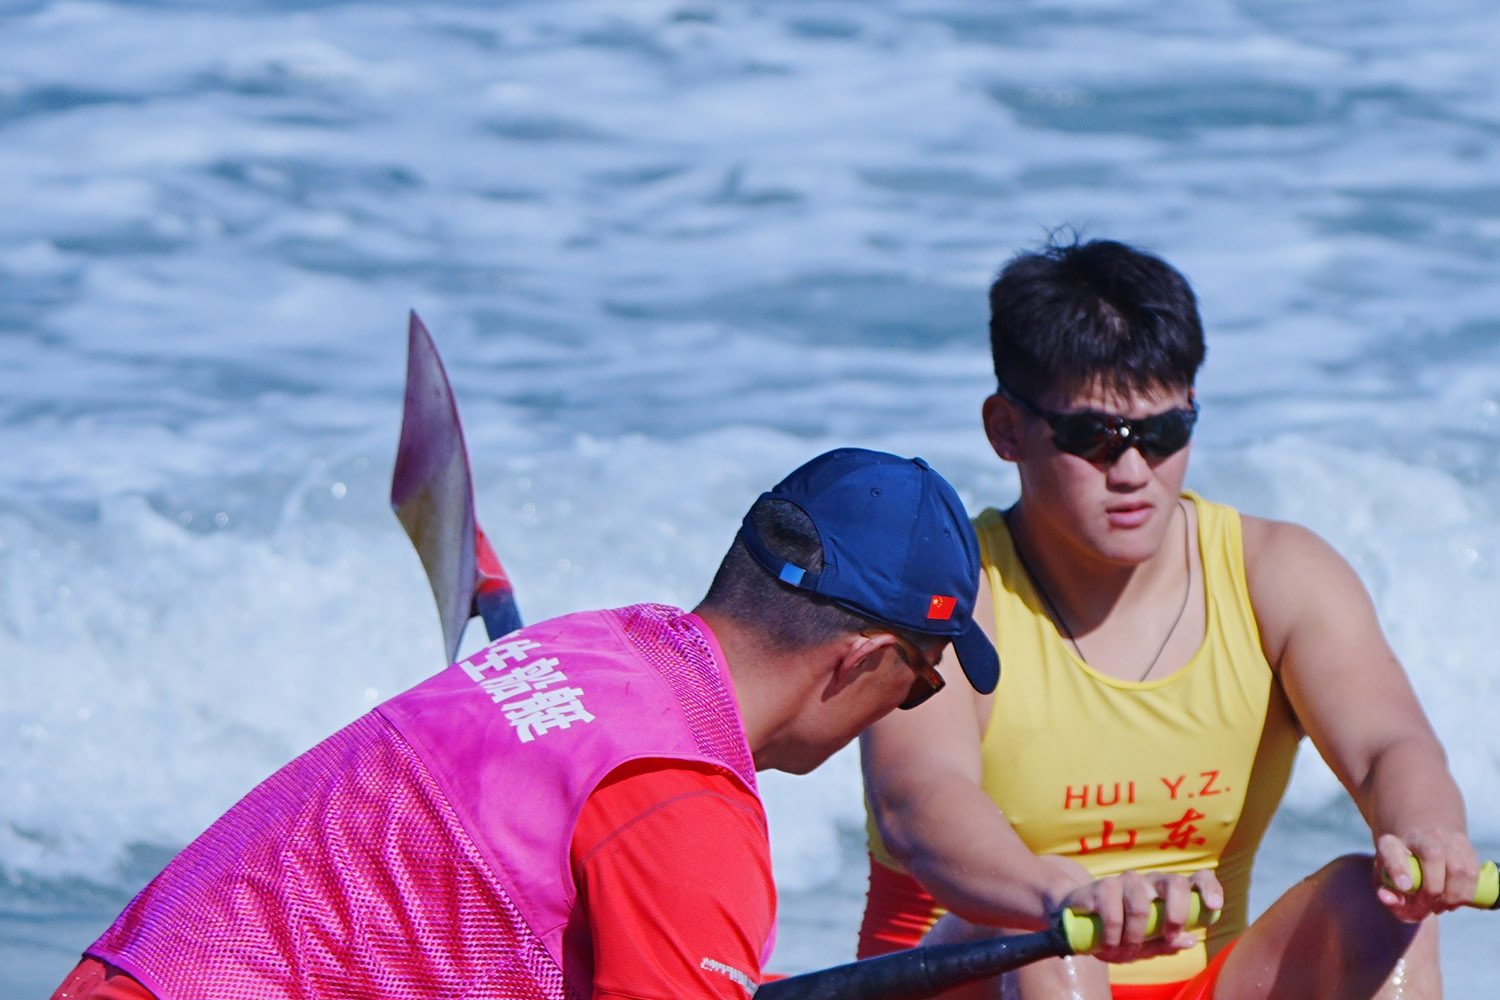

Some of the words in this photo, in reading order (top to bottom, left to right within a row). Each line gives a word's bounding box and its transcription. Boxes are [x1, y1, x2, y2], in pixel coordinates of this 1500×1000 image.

[459, 630, 596, 743] 生船艇
[1064, 780, 1135, 810] HUI
[1160, 770, 1231, 800] Y.Z.
[1078, 808, 1207, 855] 山东
